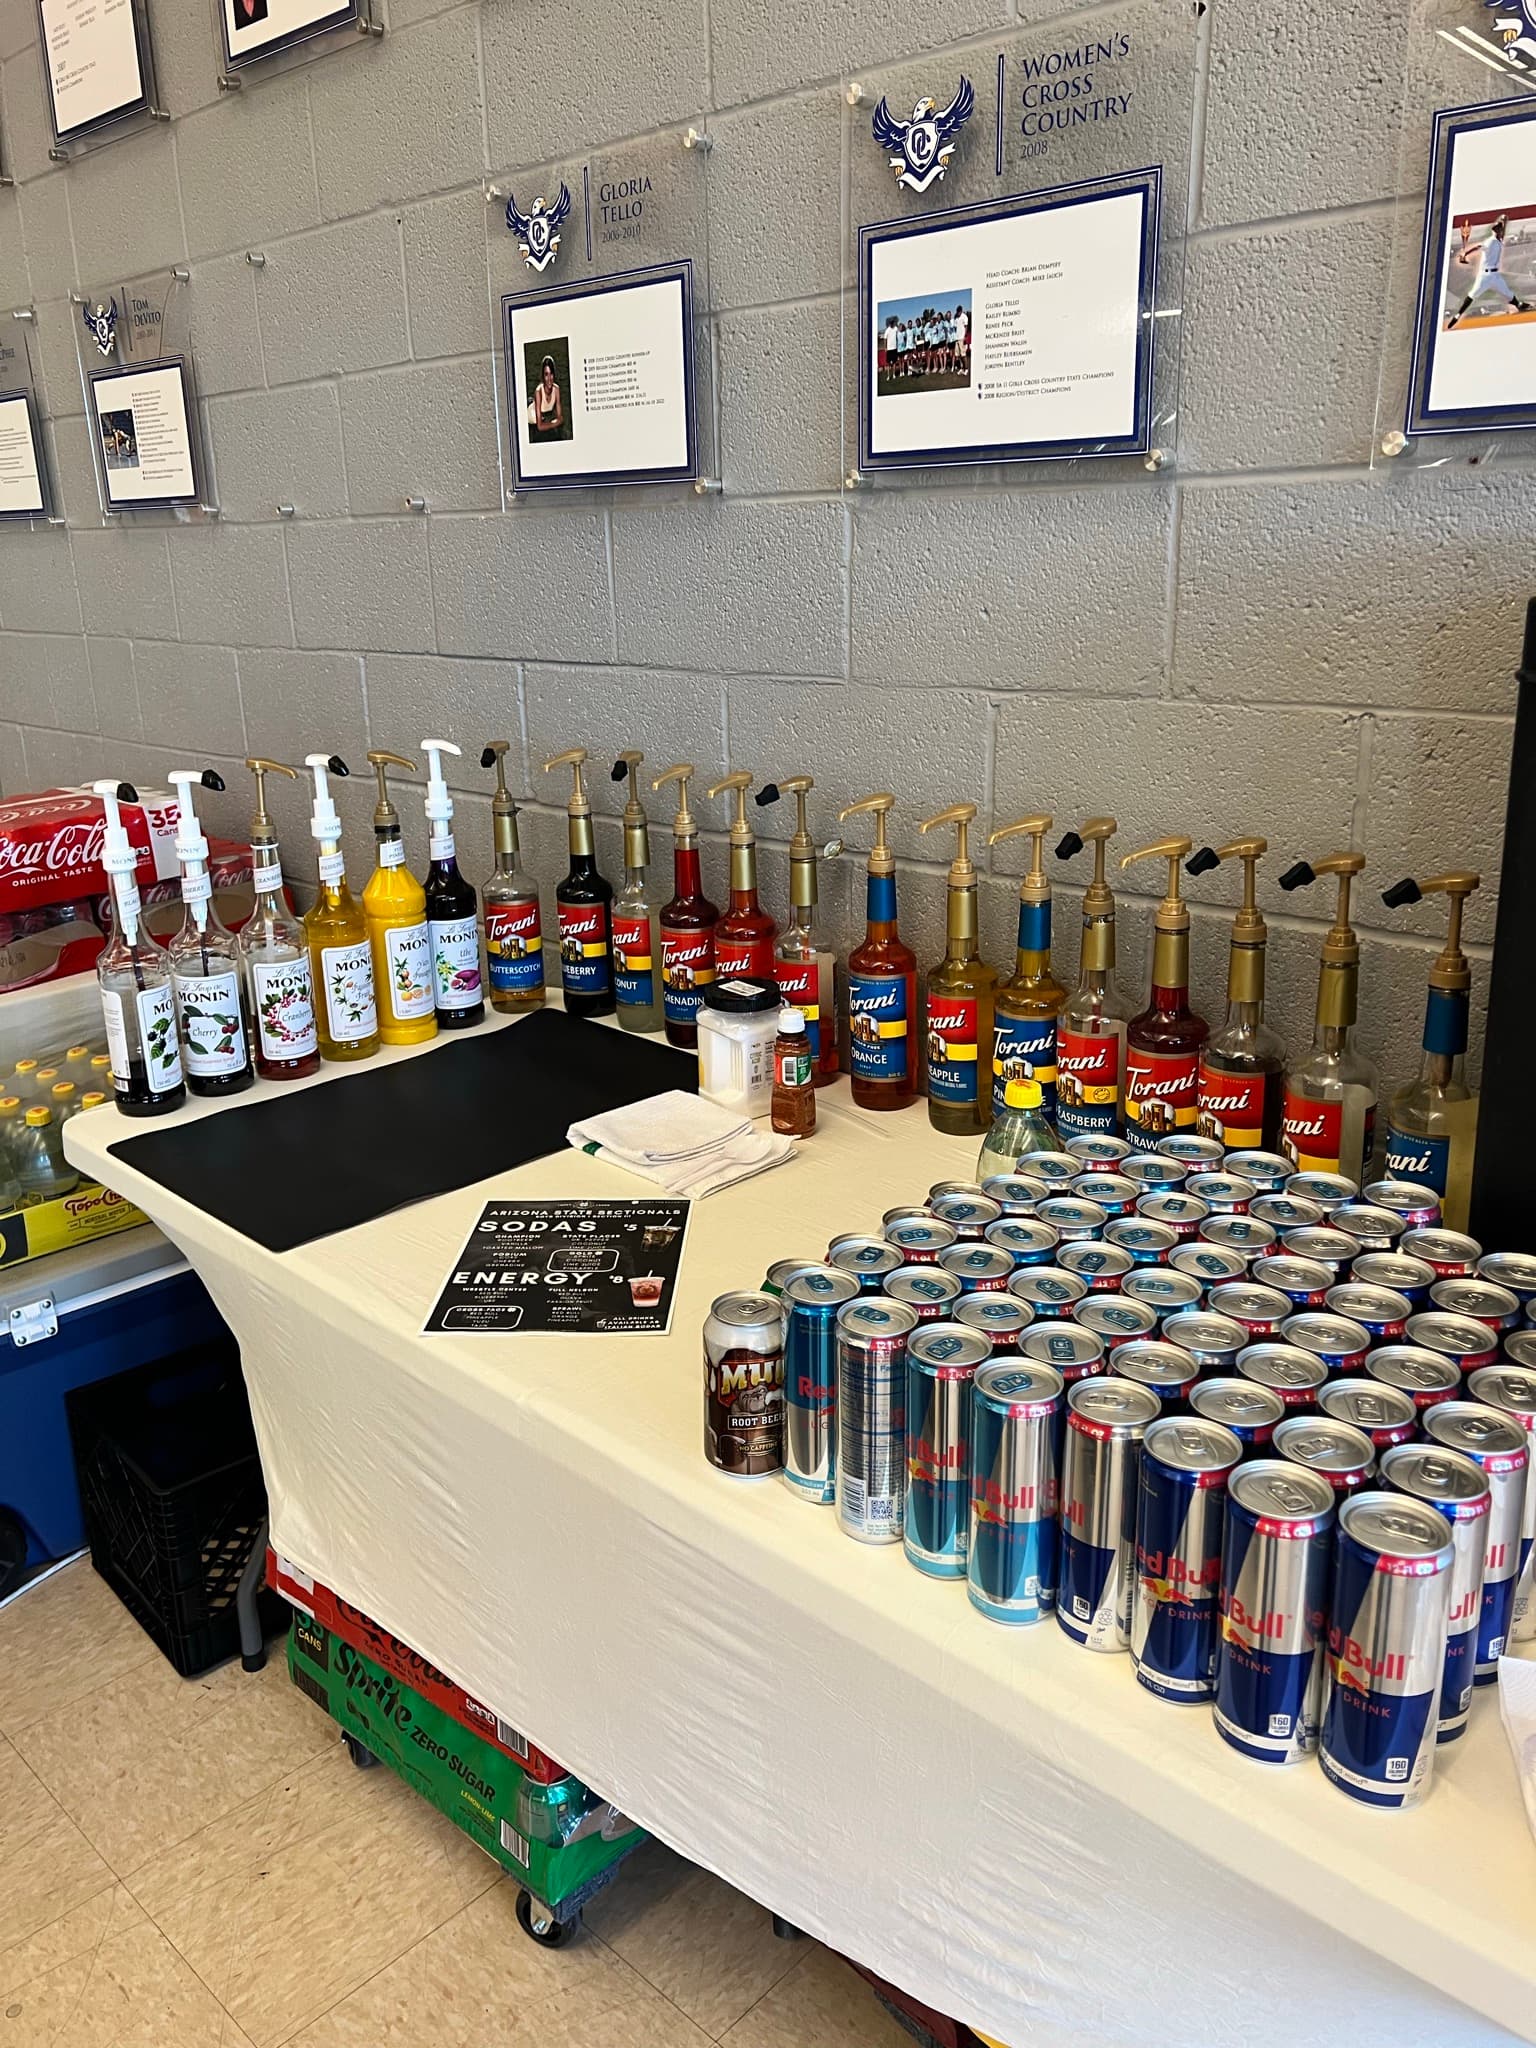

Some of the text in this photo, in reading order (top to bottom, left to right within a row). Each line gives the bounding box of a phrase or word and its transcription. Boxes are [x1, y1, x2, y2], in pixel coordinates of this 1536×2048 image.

[1022, 32, 1130, 80] WOMEN'S
[1022, 73, 1094, 108] CROSS
[1021, 93, 1133, 136] COUNTRY
[1020, 141, 1048, 159] 2008
[600, 176, 653, 202] GLORIA
[601, 201, 643, 224] TELLO
[602, 224, 641, 243] 2006-2010
[132, 299, 149, 313] TOM
[985, 299, 1020, 310] GLORIA TELLO
[1023, 378, 1040, 387] CROSS
[1041, 375, 1066, 384] COUNTRY
[1082, 371, 1115, 381] CHAMPIONS
[1040, 386, 1072, 395] CHAMPIONS
[12, 866, 94, 887] ORIGINAL TASTE
[486, 909, 537, 941] Torani
[612, 926, 641, 944] rani
[400, 938, 429, 952] MON
[661, 939, 708, 968] Torani
[336, 956, 370, 972] MONI
[490, 962, 541, 974] BUTTERSCOTCH
[562, 965, 597, 976] EBERRY
[715, 953, 750, 972] rani
[614, 978, 638, 990] CONUT
[776, 972, 808, 993] ani
[178, 990, 230, 1003] MONIN
[664, 991, 705, 1006] GRENADIN
[848, 986, 897, 1011] Torani
[927, 1008, 966, 1030] rani
[993, 1027, 1055, 1058] Torani
[851, 1046, 888, 1064] ORANGE
[1057, 1045, 1107, 1071] orani
[929, 1070, 960, 1083] EAPPLE
[1127, 1066, 1197, 1101] Torani
[1198, 1086, 1250, 1111] rani
[1283, 1114, 1326, 1136] rani
[1126, 1128, 1159, 1151] STRAW
[1386, 1150, 1432, 1172] rani
[65, 1195, 100, 1216] Topo
[478, 1220, 598, 1233] SODAS
[452, 1271, 593, 1285] ENERGY
[732, 1417, 758, 1427] ROOT
[917, 1438, 967, 1468] Bull
[986, 1480, 1034, 1509] Bull
[1136, 1545, 1164, 1577] ed
[1167, 1607, 1212, 1621] DRINK
[1449, 1590, 1476, 1621] ull
[1229, 1595, 1284, 1639] Bull
[297, 1627, 323, 1652] CANS
[1229, 1651, 1272, 1676] DRINK
[1351, 1637, 1404, 1681] Bull
[1343, 1694, 1392, 1719] DRINK
[334, 1643, 413, 1732] Sprite
[410, 1725, 450, 1761] ZERO
[449, 1755, 496, 1802] SUGAR
[1271, 1716, 1289, 1727] 160
[1391, 1760, 1407, 1770] 160
[461, 1789, 496, 1822] LEMON-LIME
